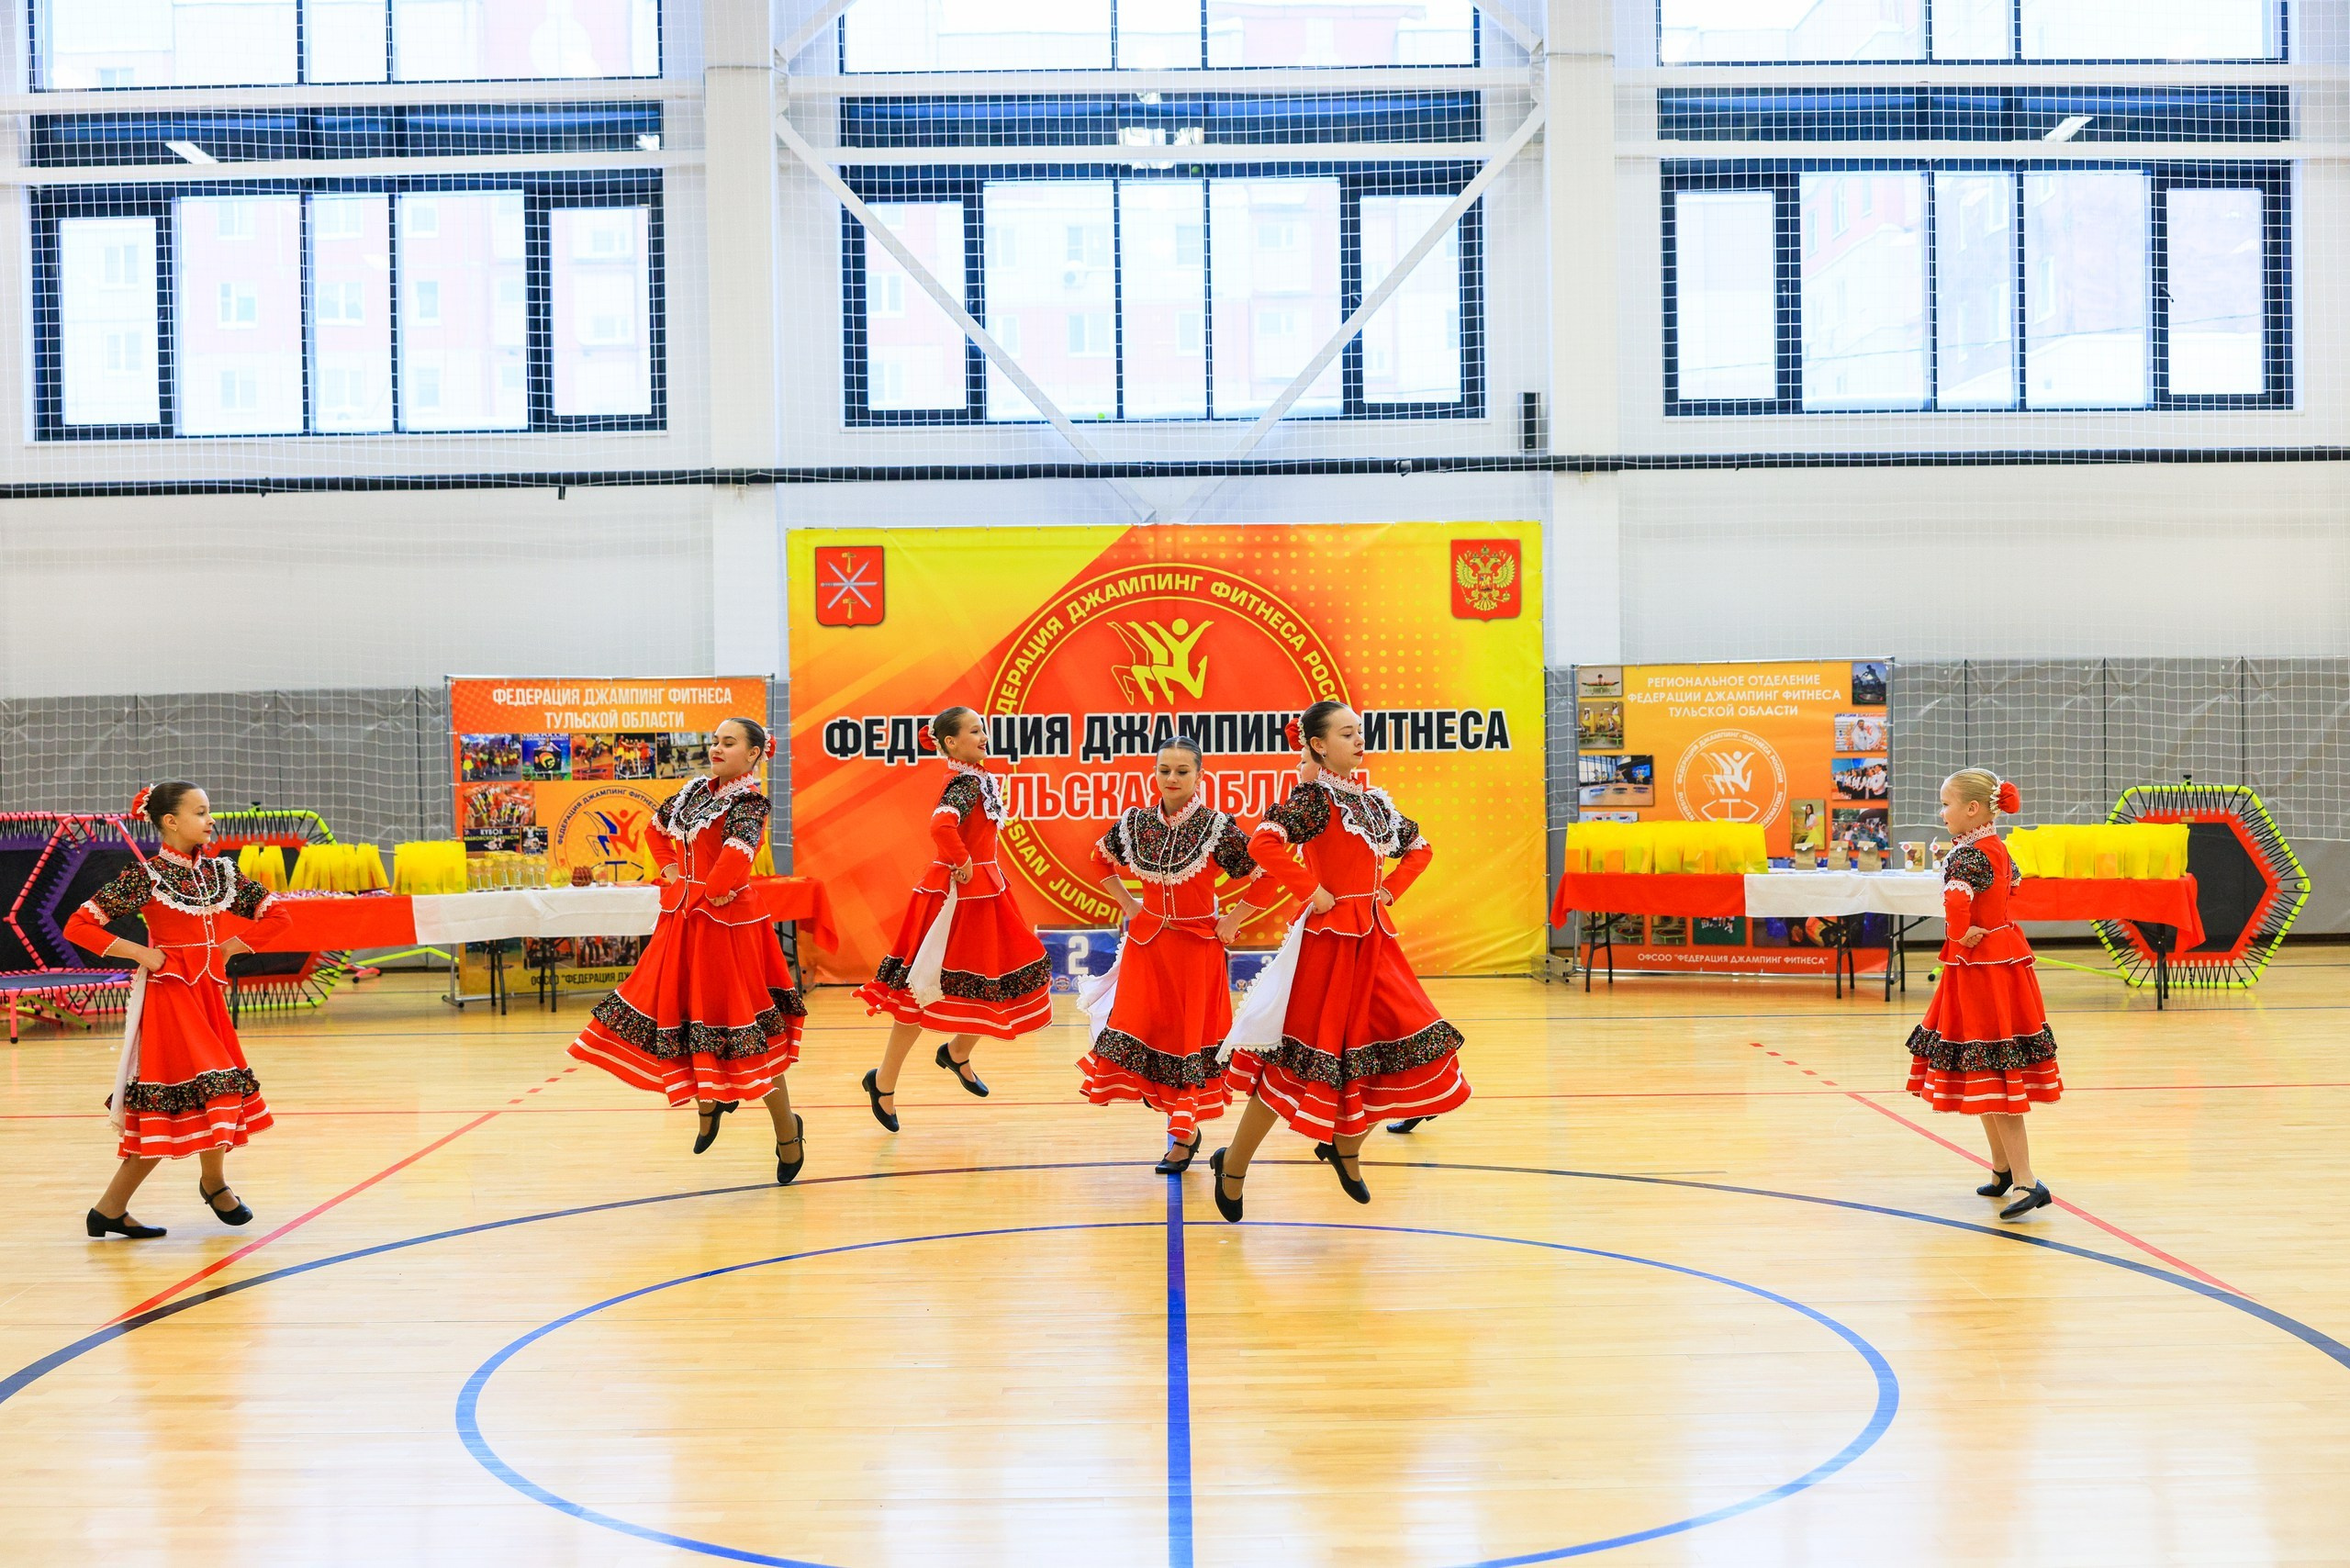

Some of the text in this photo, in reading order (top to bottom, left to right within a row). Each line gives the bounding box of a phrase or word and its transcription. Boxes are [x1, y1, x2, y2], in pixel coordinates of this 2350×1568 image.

[995, 615, 1065, 715] ДЕРАЦИЯ
[1065, 573, 1203, 624] ДЖАМПИНГ
[1210, 581, 1307, 653] ФИТНЕСА
[1648, 674, 1820, 688] РЕГИОНАЛЬНОЕ ОТДЕЛЕНИЕ
[492, 687, 733, 707] ФЕДЕРАЦИЯ ДЖАМПИНГ ФИТНЕСА
[1628, 689, 1841, 704] ФЕДЕРАЦИИ ДЖАМПИНГ ФИТНЕСА
[544, 709, 685, 729] ТУЛЬСКОЙ ОБЛАСТИ
[1668, 703, 1798, 717] ТУЛЬСКОЙ ОБЛАСТИ
[823, 708, 1512, 766] ФЕДЦИЯ ДЖАМПИН ИТНЕСА
[557, 789, 658, 846] ФЕДЕРАЦИЯ ДЖАМПИНГ ФИТНЕС
[1048, 878, 1123, 925] JUMPI
[1067, 935, 1090, 975] 2
[1638, 953, 1829, 965] ОФСОО "ФЕДЕРАЦИЯ ДЖАМПИНГ ФИТНЕСА"
[562, 971, 616, 985] "ФЕДЕРАЦИЯ
